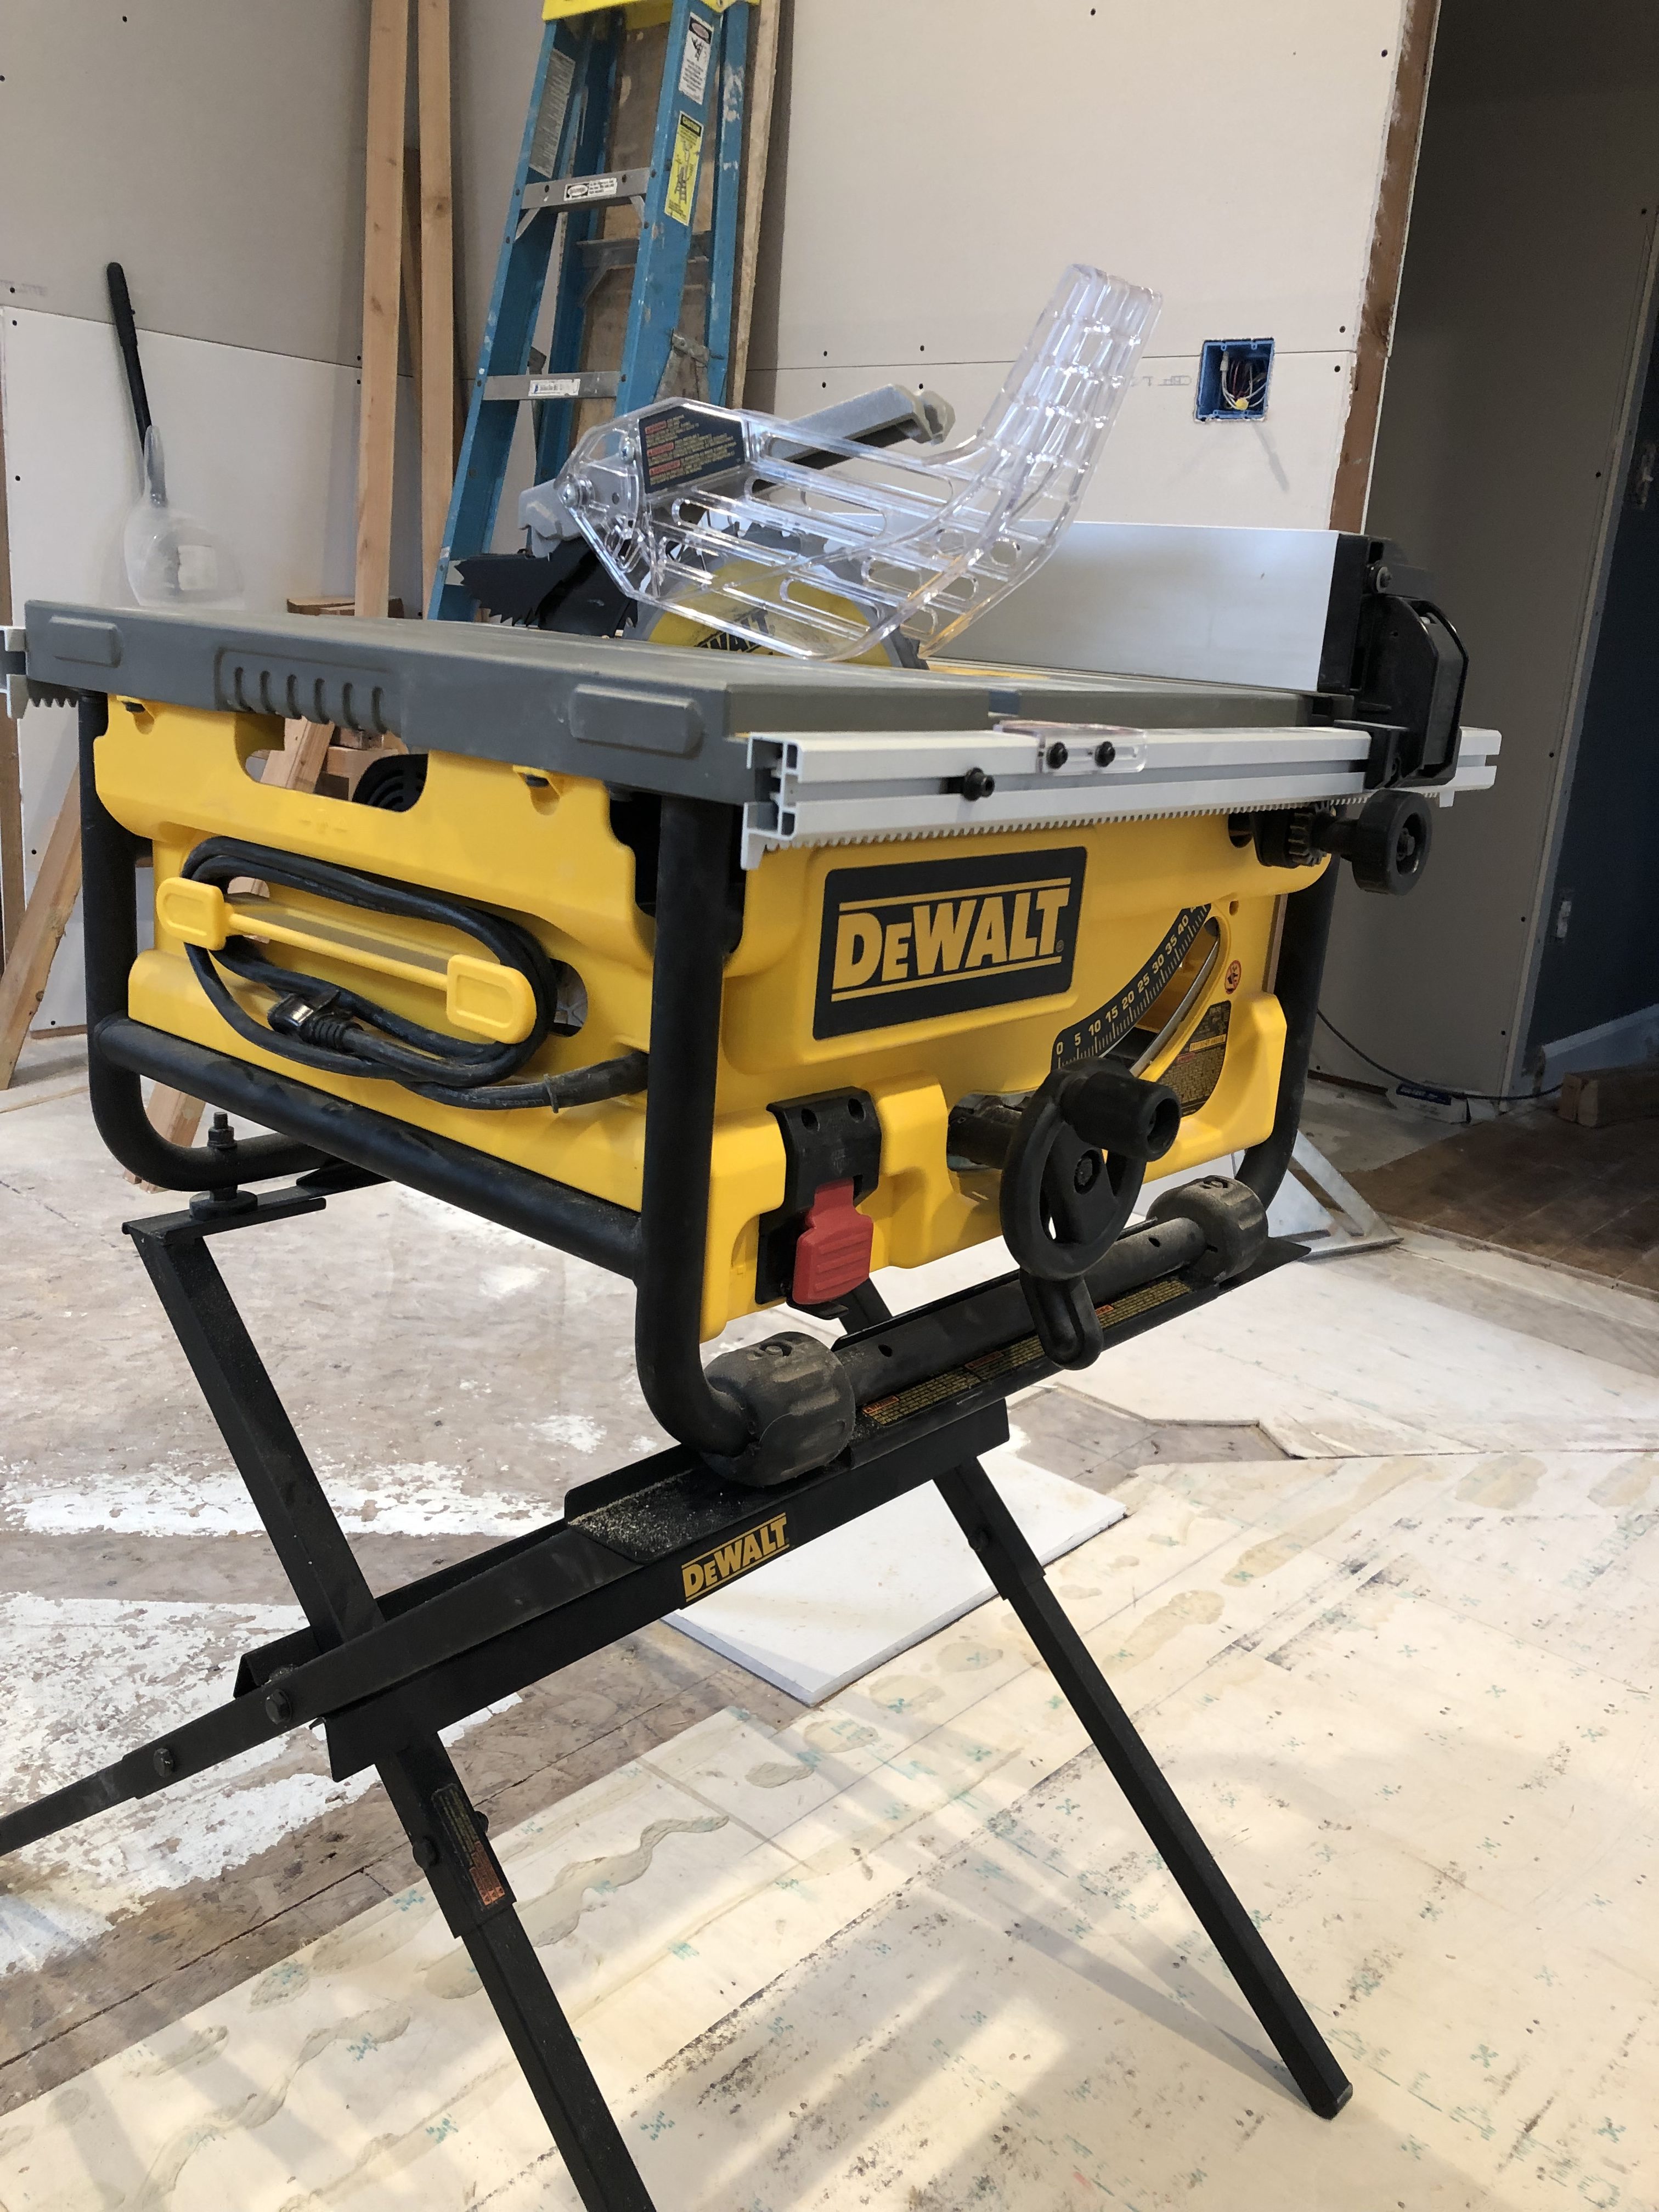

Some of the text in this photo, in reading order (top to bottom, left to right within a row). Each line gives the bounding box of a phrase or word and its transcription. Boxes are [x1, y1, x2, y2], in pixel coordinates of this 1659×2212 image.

[1056, 915, 1189, 1055] 0 5 10 15 20 25 30 35 40
